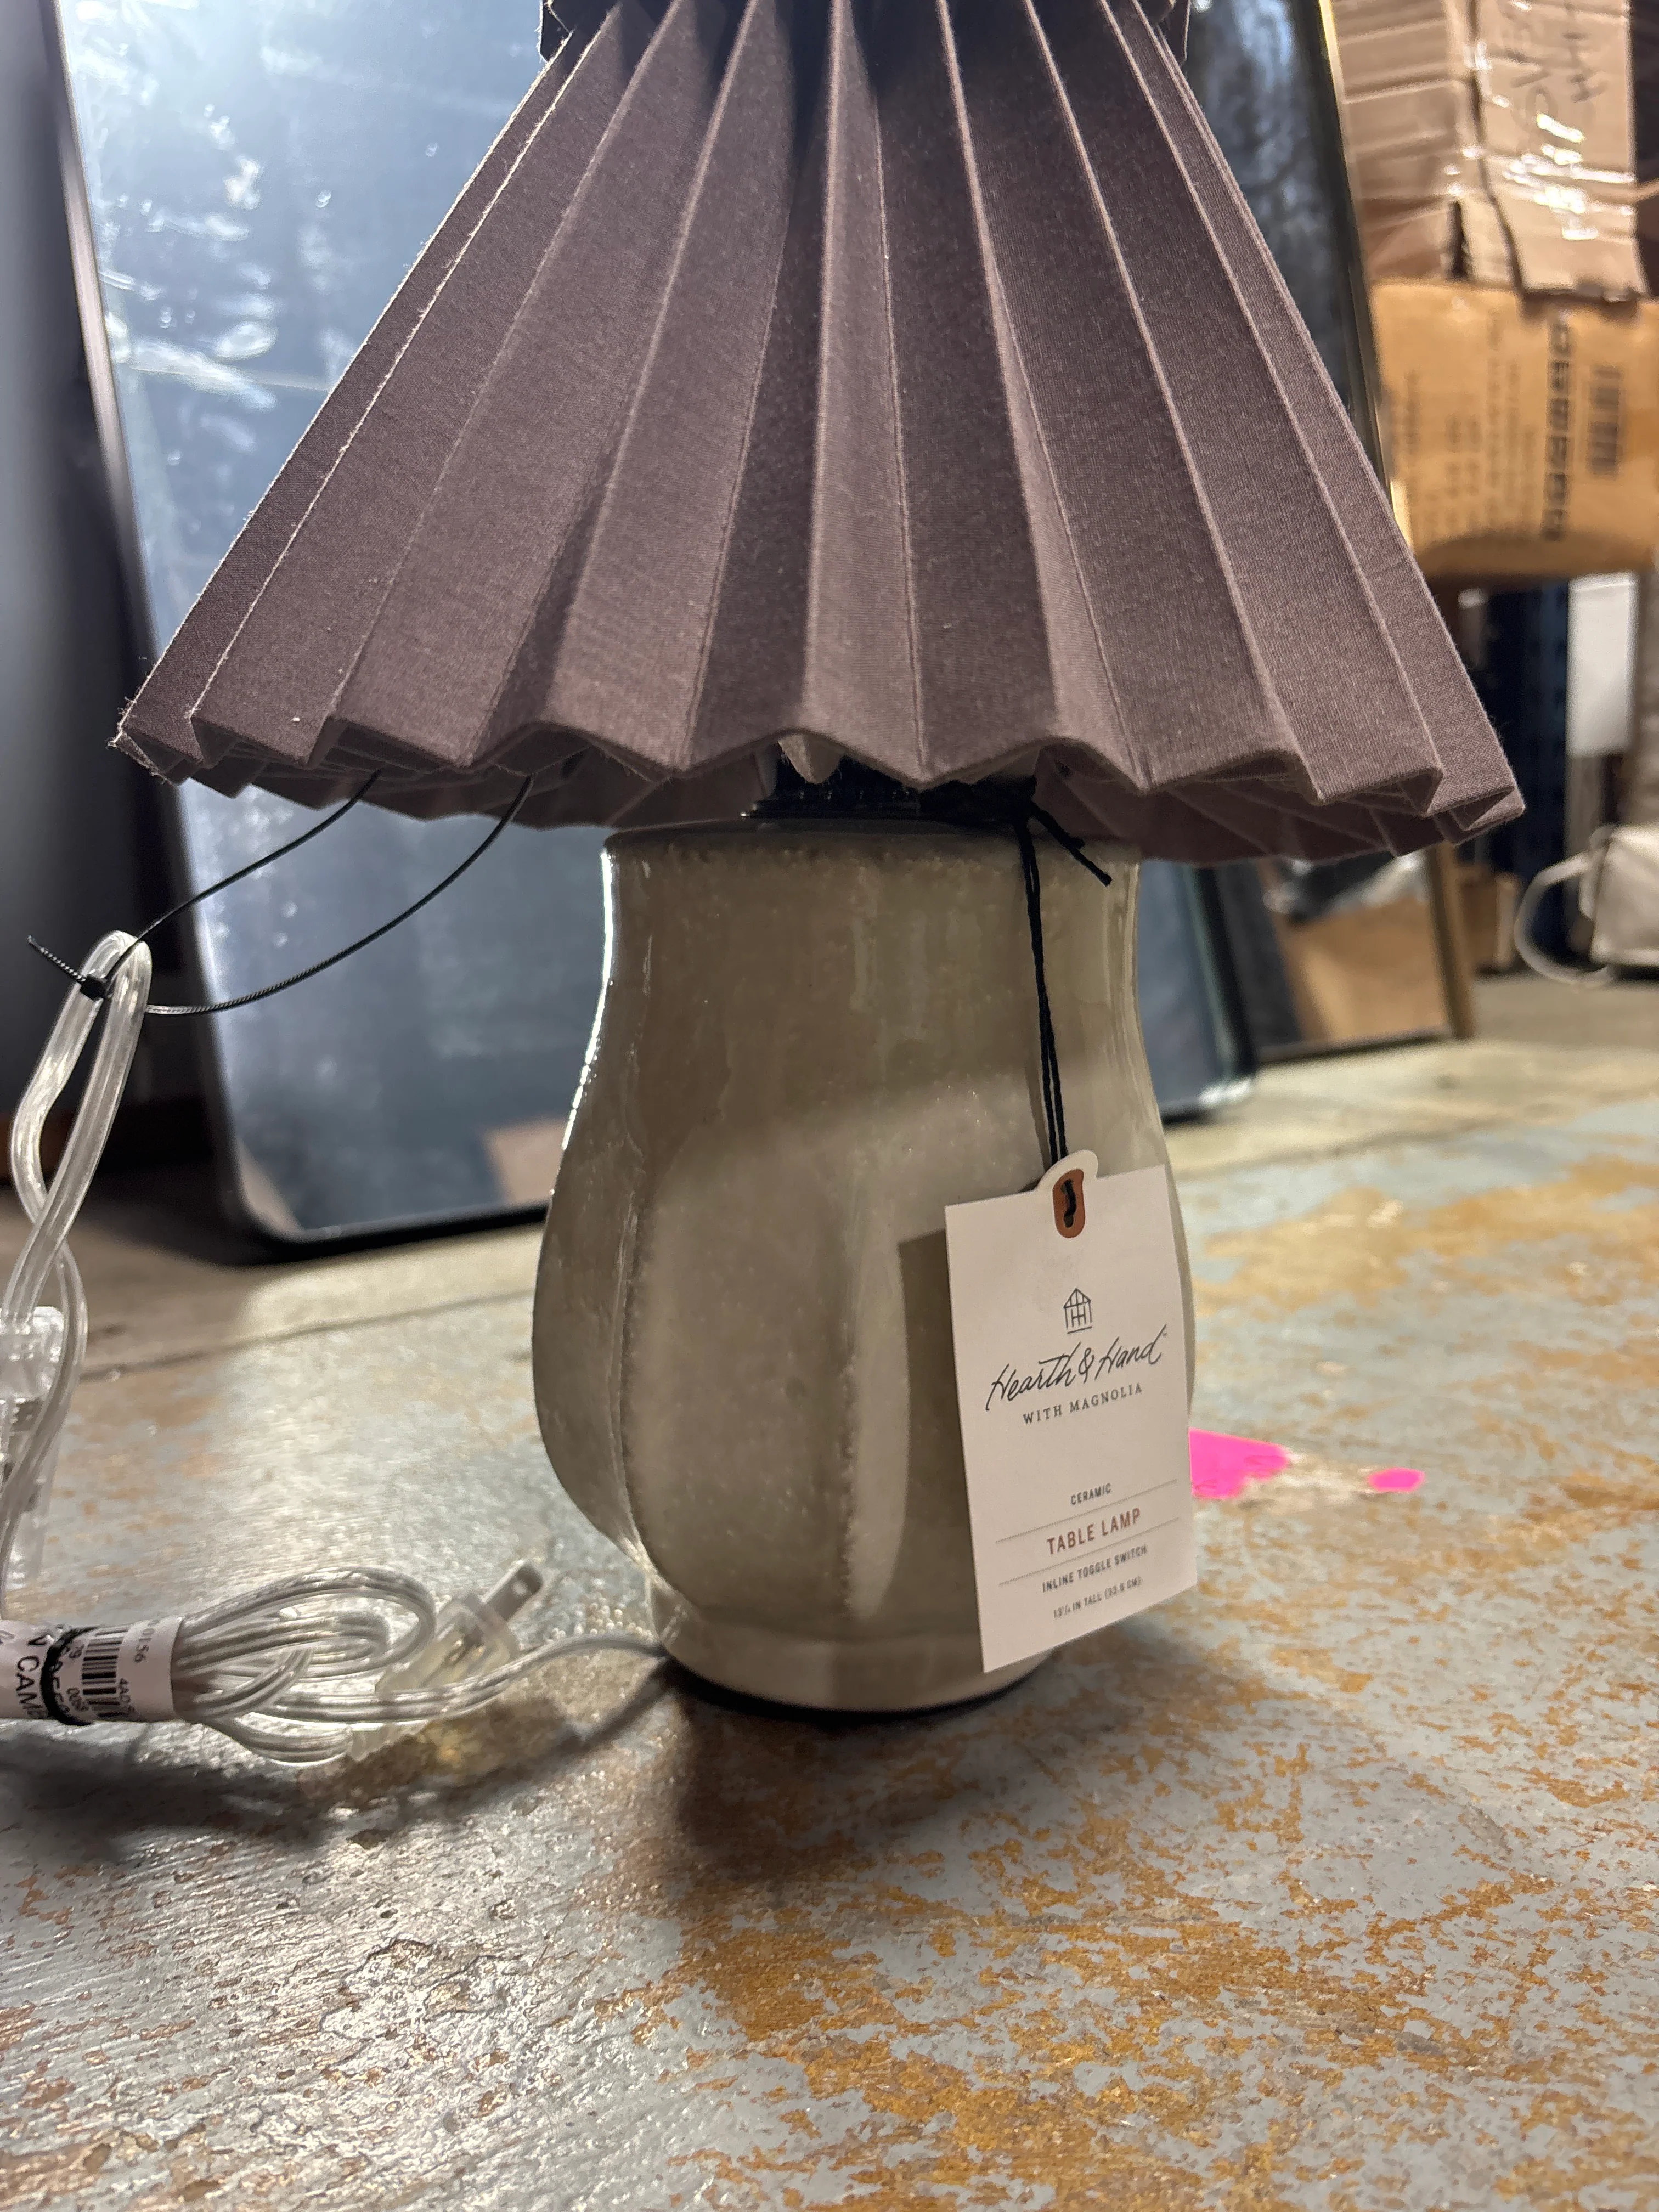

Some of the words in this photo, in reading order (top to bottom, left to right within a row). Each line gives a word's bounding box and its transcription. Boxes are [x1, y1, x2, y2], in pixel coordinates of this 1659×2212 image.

[985, 1341, 1081, 1411] Hearth
[1078, 1347, 1094, 1384] &
[1023, 1403, 1063, 1425] WITH
[1069, 1382, 1143, 1413] MAGNOLIA
[1070, 1482, 1111, 1506] CERAMIC
[1046, 1523, 1095, 1554] TABLE
[1101, 1507, 1141, 1536] LAMP
[1042, 1572, 1074, 1593] INLINE
[1077, 1558, 1111, 1579] TOGGLE
[1114, 1544, 1148, 1565] SWITCH
[1084, 1592, 1103, 1606] TALL
